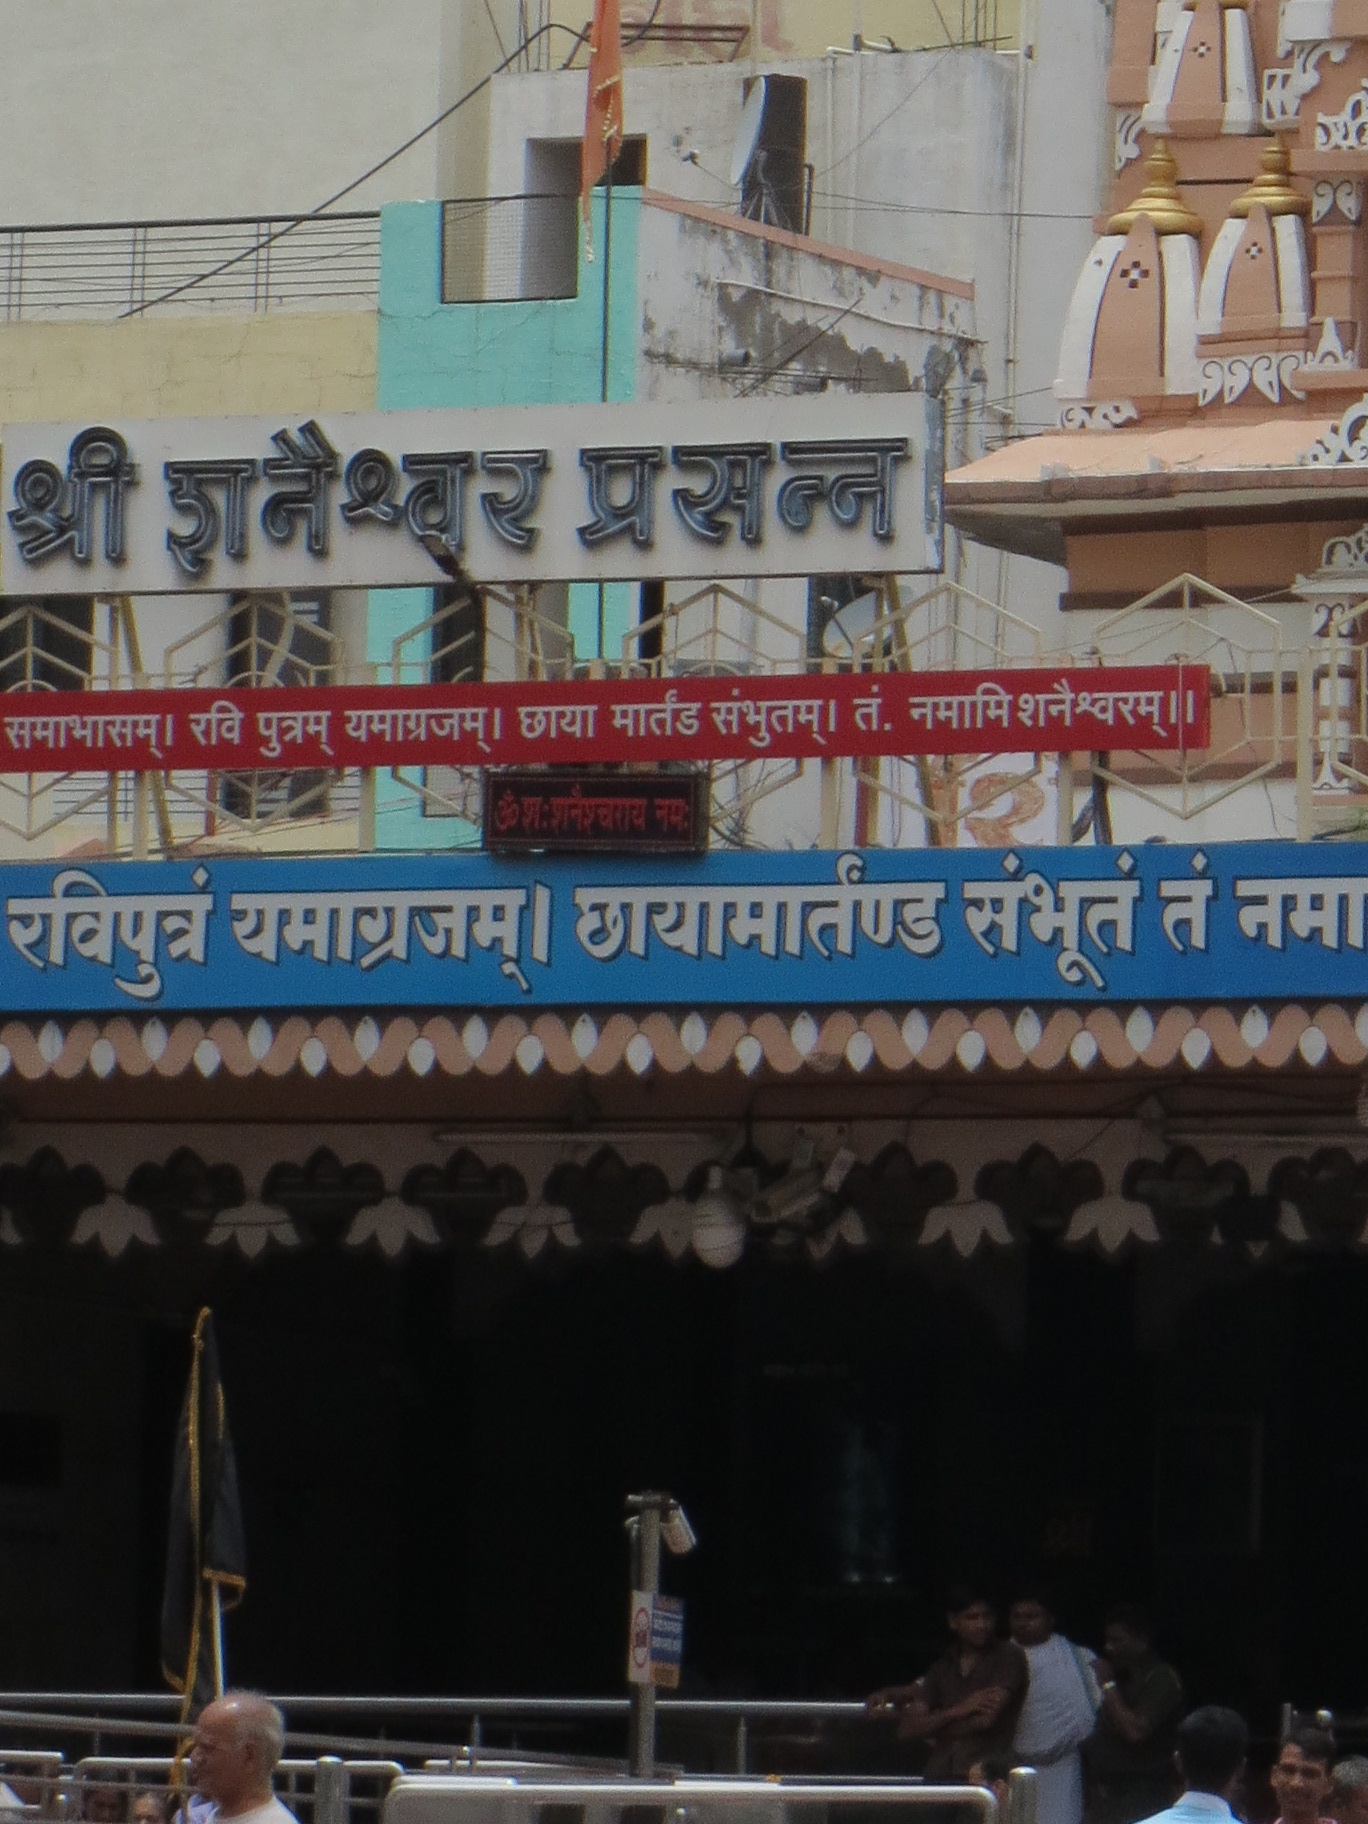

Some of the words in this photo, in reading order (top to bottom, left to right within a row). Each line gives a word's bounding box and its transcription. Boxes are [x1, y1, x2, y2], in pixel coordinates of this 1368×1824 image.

[8, 425, 138, 564] श्री
[578, 438, 910, 546] प्रसन्न
[189, 700, 244, 746] रवि
[257, 710, 335, 758] पुत्रम्
[518, 704, 598, 740] छाया
[909, 682, 1013, 730] नमामि
[6, 866, 217, 1000] रविपुत्रं
[962, 850, 1142, 990] संभूतं
[1158, 850, 1214, 954] तं
